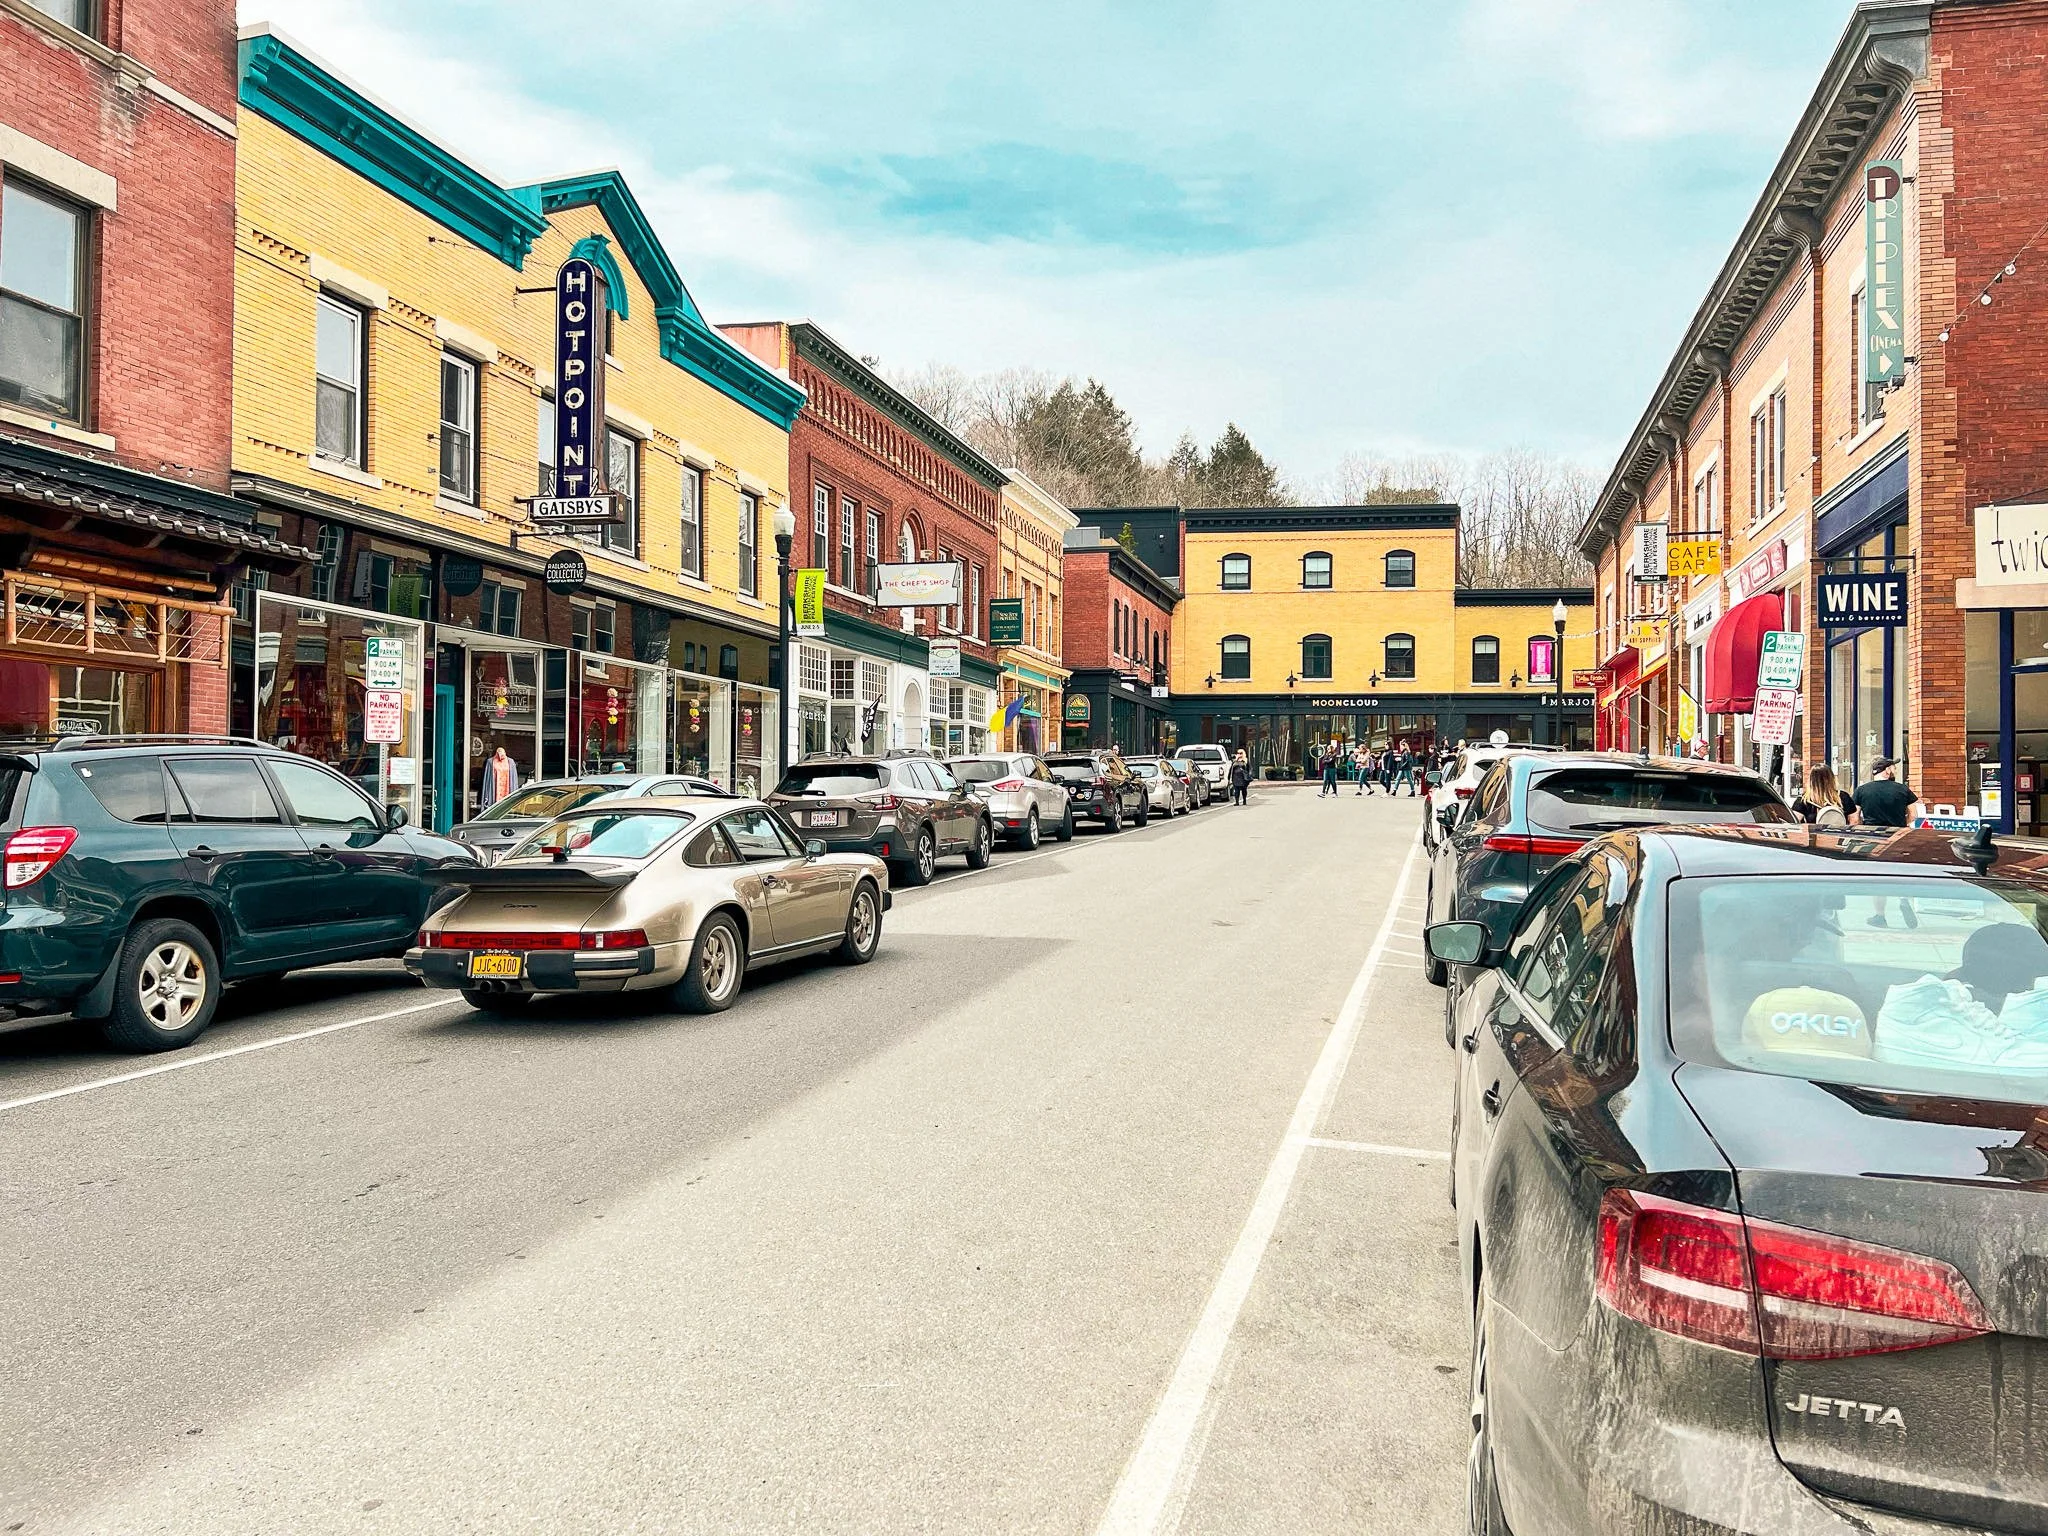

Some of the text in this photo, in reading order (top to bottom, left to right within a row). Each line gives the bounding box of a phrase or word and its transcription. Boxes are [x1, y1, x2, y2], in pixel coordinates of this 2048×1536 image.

[1869, 177, 1899, 330] TRIPLEX
[1870, 334, 1902, 352] CINEMA
[563, 270, 586, 496] HOTPOINT
[539, 500, 603, 515] GATSBYS
[1669, 545, 1717, 559] CAFE
[547, 562, 577, 570] RAILROAD
[546, 569, 584, 579] COLLECTIVE
[1825, 582, 1899, 612] WINE
[369, 641, 378, 655] 2
[1765, 635, 1776, 650] 2
[1312, 699, 1379, 707] MOONCLOUD
[1771, 692, 1782, 700] NO
[369, 701, 399, 709] PARKING
[1760, 699, 1792, 709] PARKING
[454, 938, 563, 946] PORSCHE
[1769, 1012, 1862, 1039] OAKLEY
[1785, 1393, 1907, 1430] JETTA
